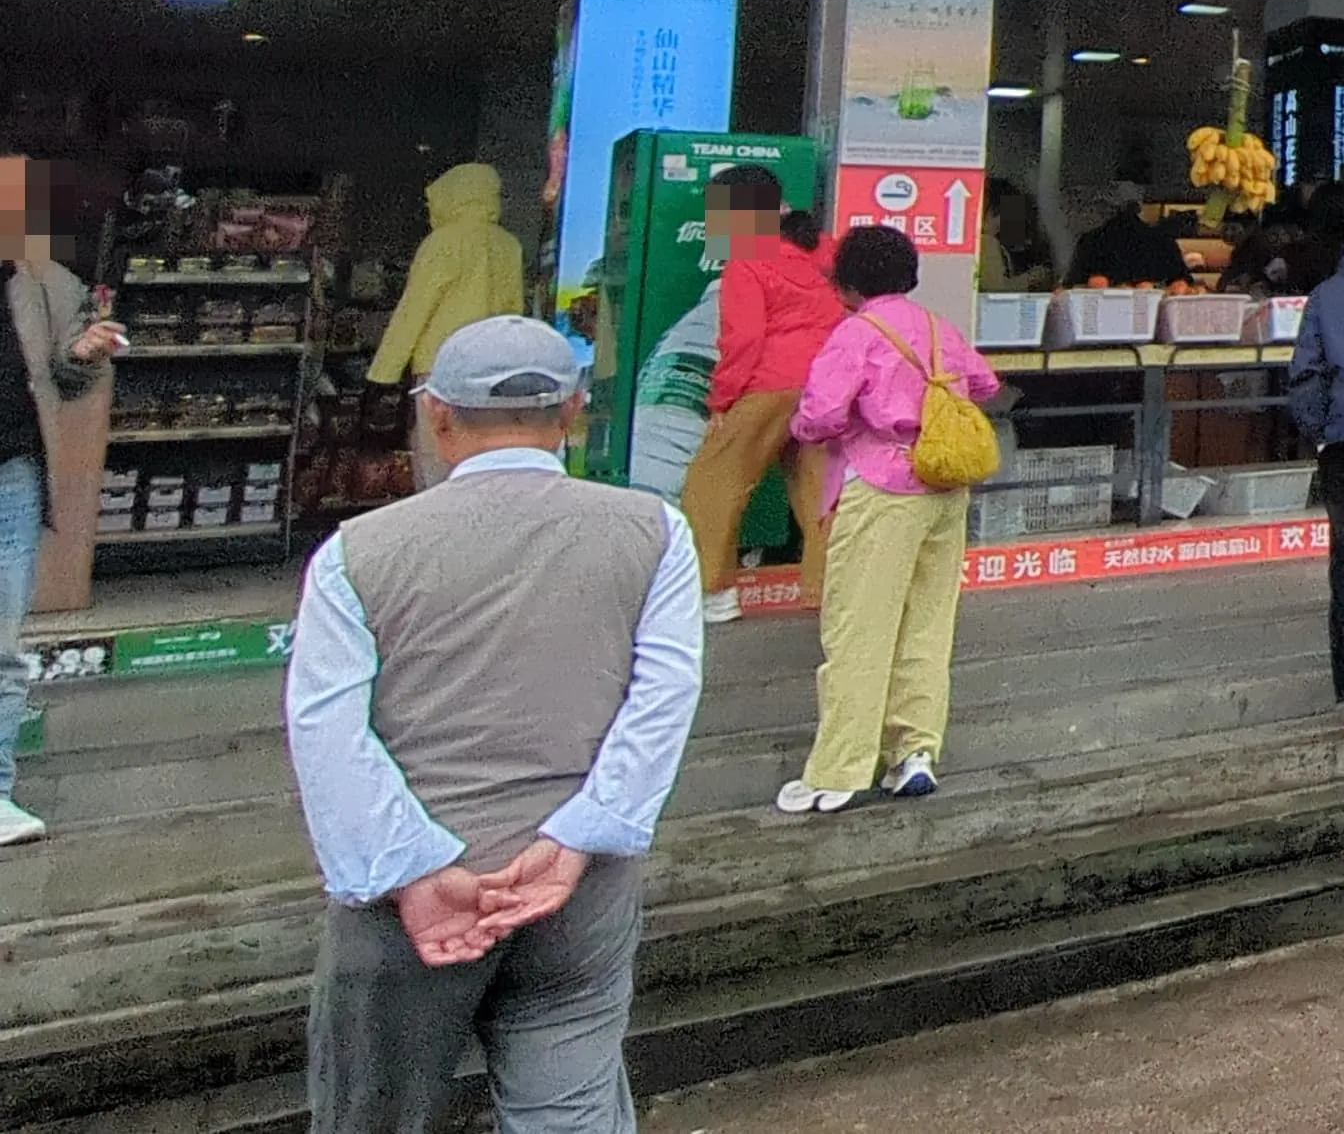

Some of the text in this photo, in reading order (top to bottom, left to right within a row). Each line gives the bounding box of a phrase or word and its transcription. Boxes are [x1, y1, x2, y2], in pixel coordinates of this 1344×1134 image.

[692, 143, 781, 159] TEAM CHINA
[1104, 545, 1175, 570] 天然好水
[1177, 536, 1261, 561] 源自峨眉山
